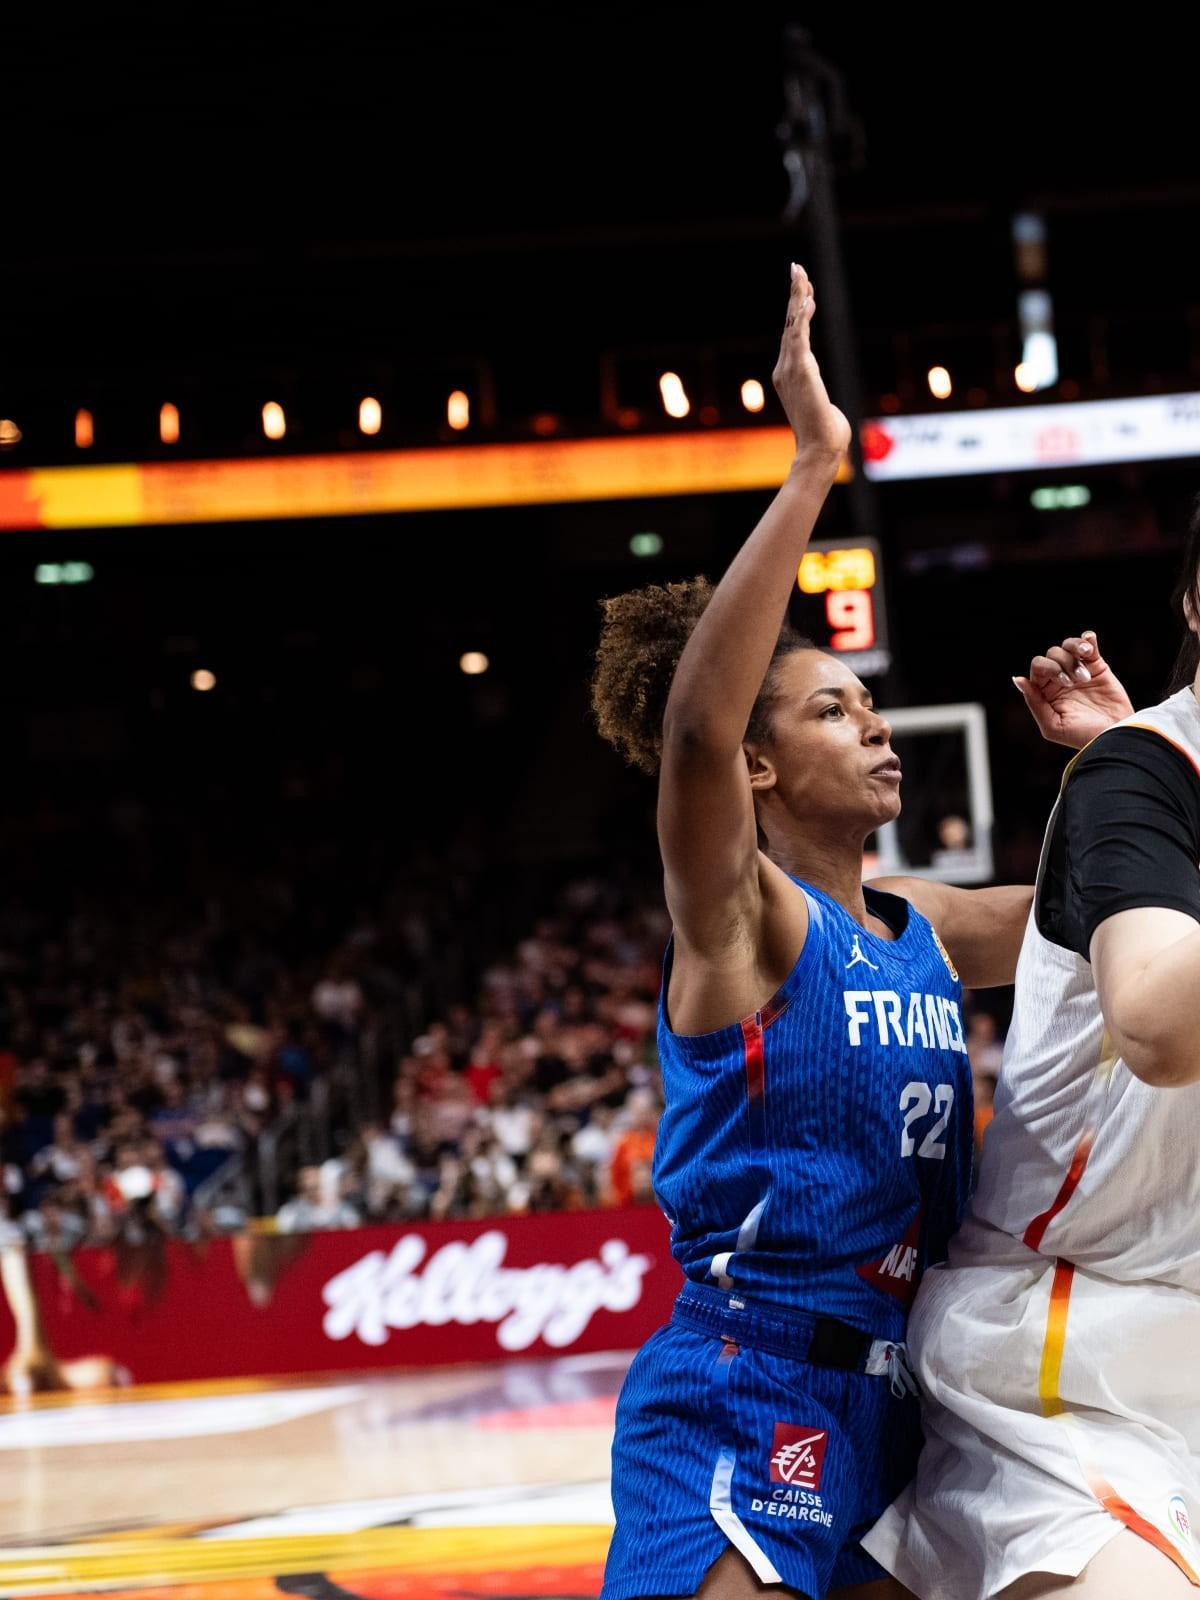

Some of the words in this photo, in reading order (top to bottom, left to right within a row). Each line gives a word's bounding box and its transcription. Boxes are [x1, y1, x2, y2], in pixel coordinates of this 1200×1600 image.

[826, 590, 874, 651] 9
[899, 1081, 955, 1160] 22
[322, 1230, 650, 1351] Kellogg's
[751, 1498, 833, 1528] D'EPARGNE
[772, 1489, 823, 1508] CAISSE
